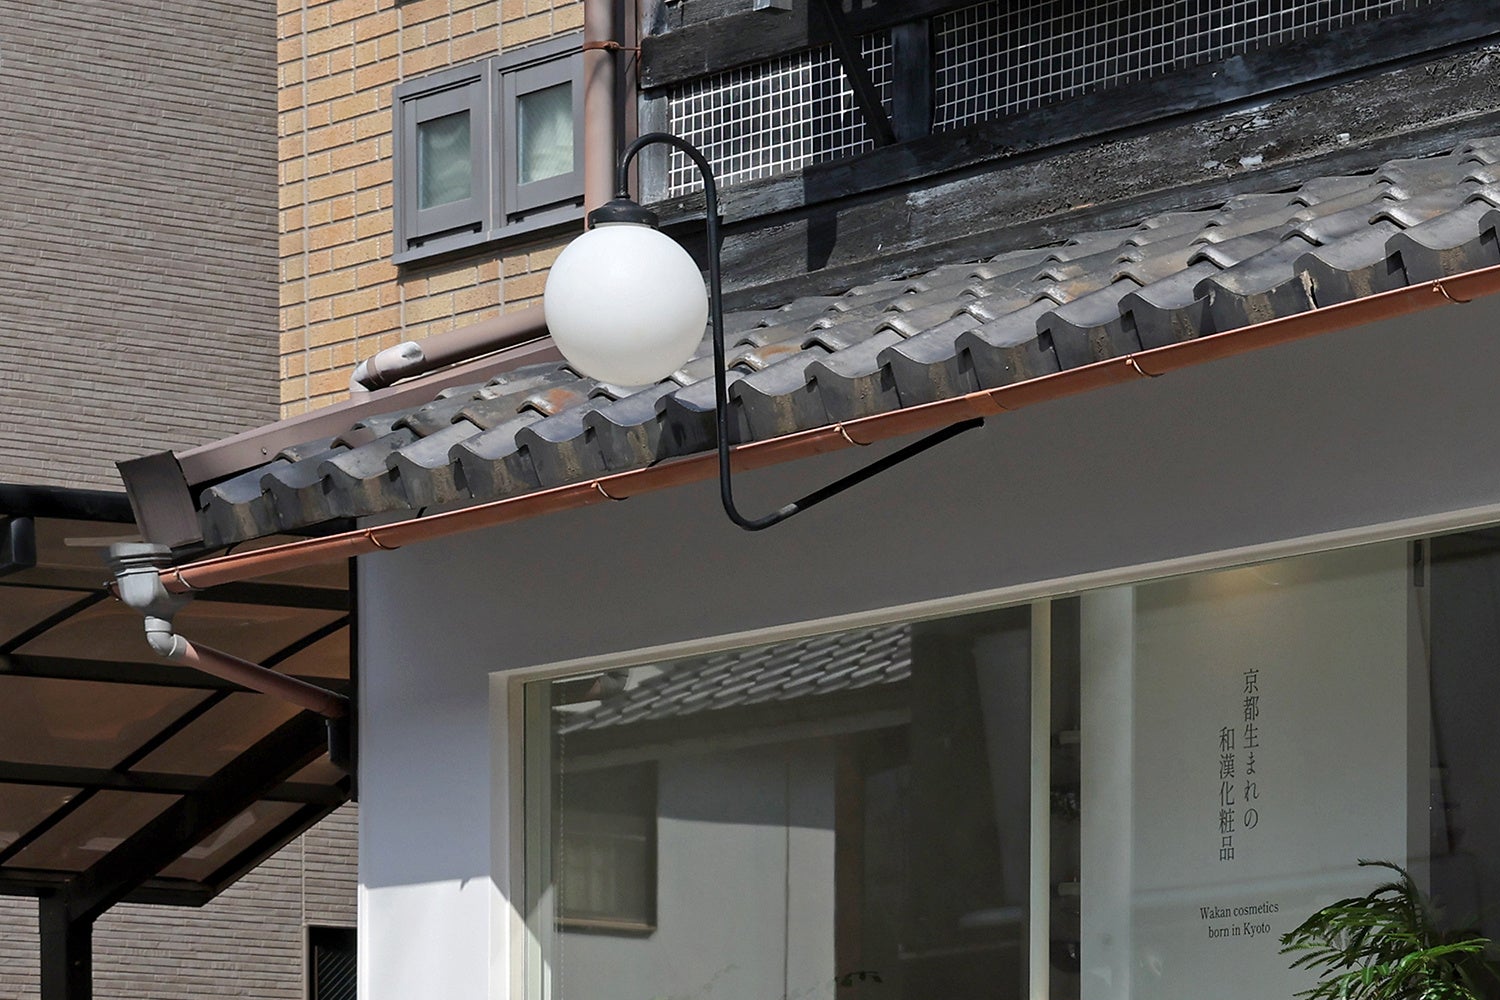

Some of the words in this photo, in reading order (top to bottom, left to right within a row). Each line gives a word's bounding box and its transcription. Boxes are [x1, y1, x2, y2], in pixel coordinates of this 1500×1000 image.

[1243, 668, 1260, 830] 京都生まれの
[1219, 726, 1235, 862] 和漢化粧品
[1200, 906, 1231, 919] Wakan
[1233, 901, 1279, 917] cosmetics
[1208, 926, 1229, 938] born
[1232, 924, 1240, 936] in
[1243, 922, 1271, 937] Kyoto
